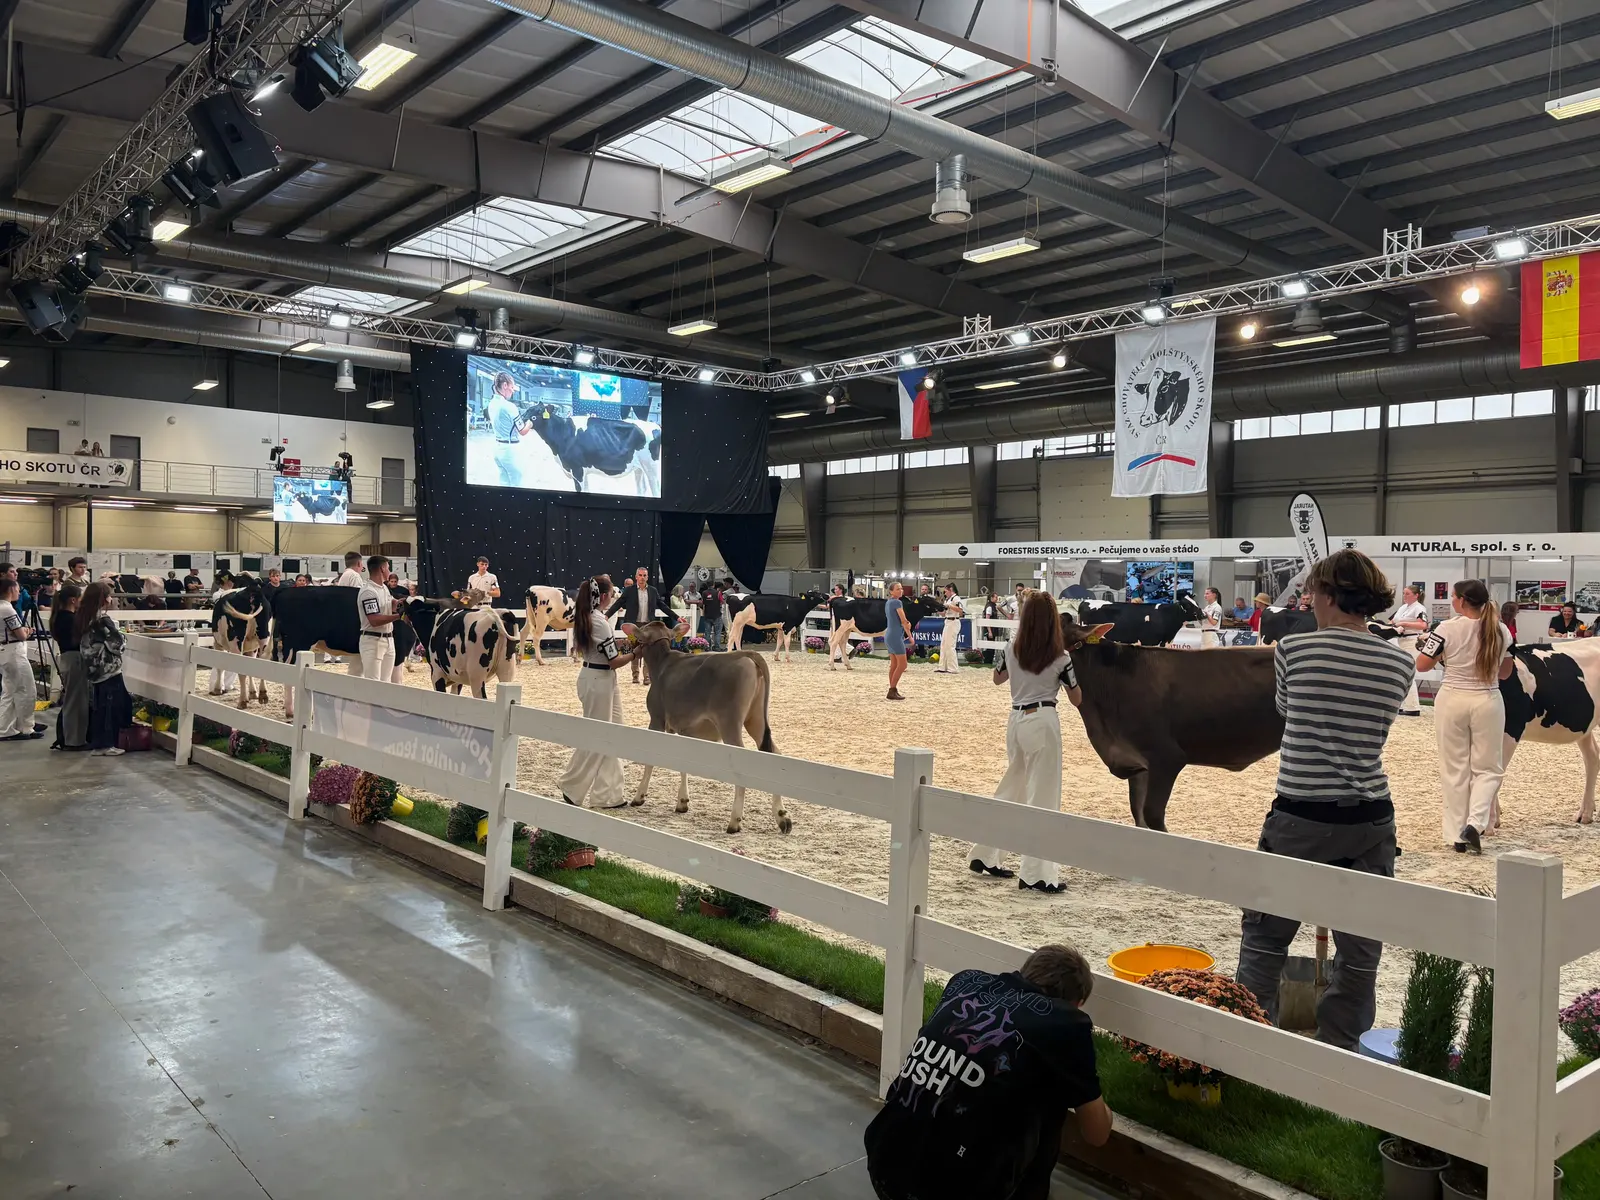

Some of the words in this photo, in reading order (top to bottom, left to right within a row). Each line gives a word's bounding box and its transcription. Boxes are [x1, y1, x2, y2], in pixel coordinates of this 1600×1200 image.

[1155, 434, 1167, 445] ČR
[25, 461, 76, 474] SKOTU
[80, 463, 101, 476] ČR
[998, 547, 1039, 555] FORESTRIS
[1099, 545, 1141, 556] Pečujeme
[1149, 544, 1171, 554] vaše
[1172, 544, 1200, 554] stádo
[1391, 541, 1466, 553] NATURAL,
[1470, 541, 1508, 553] spol.
[1512, 543, 1521, 552] s
[1526, 542, 1536, 551] r.
[1541, 542, 1556, 551] o.
[608, 645, 614, 653] 4
[911, 1036, 986, 1088] OUND
[900, 1057, 951, 1096] USH
